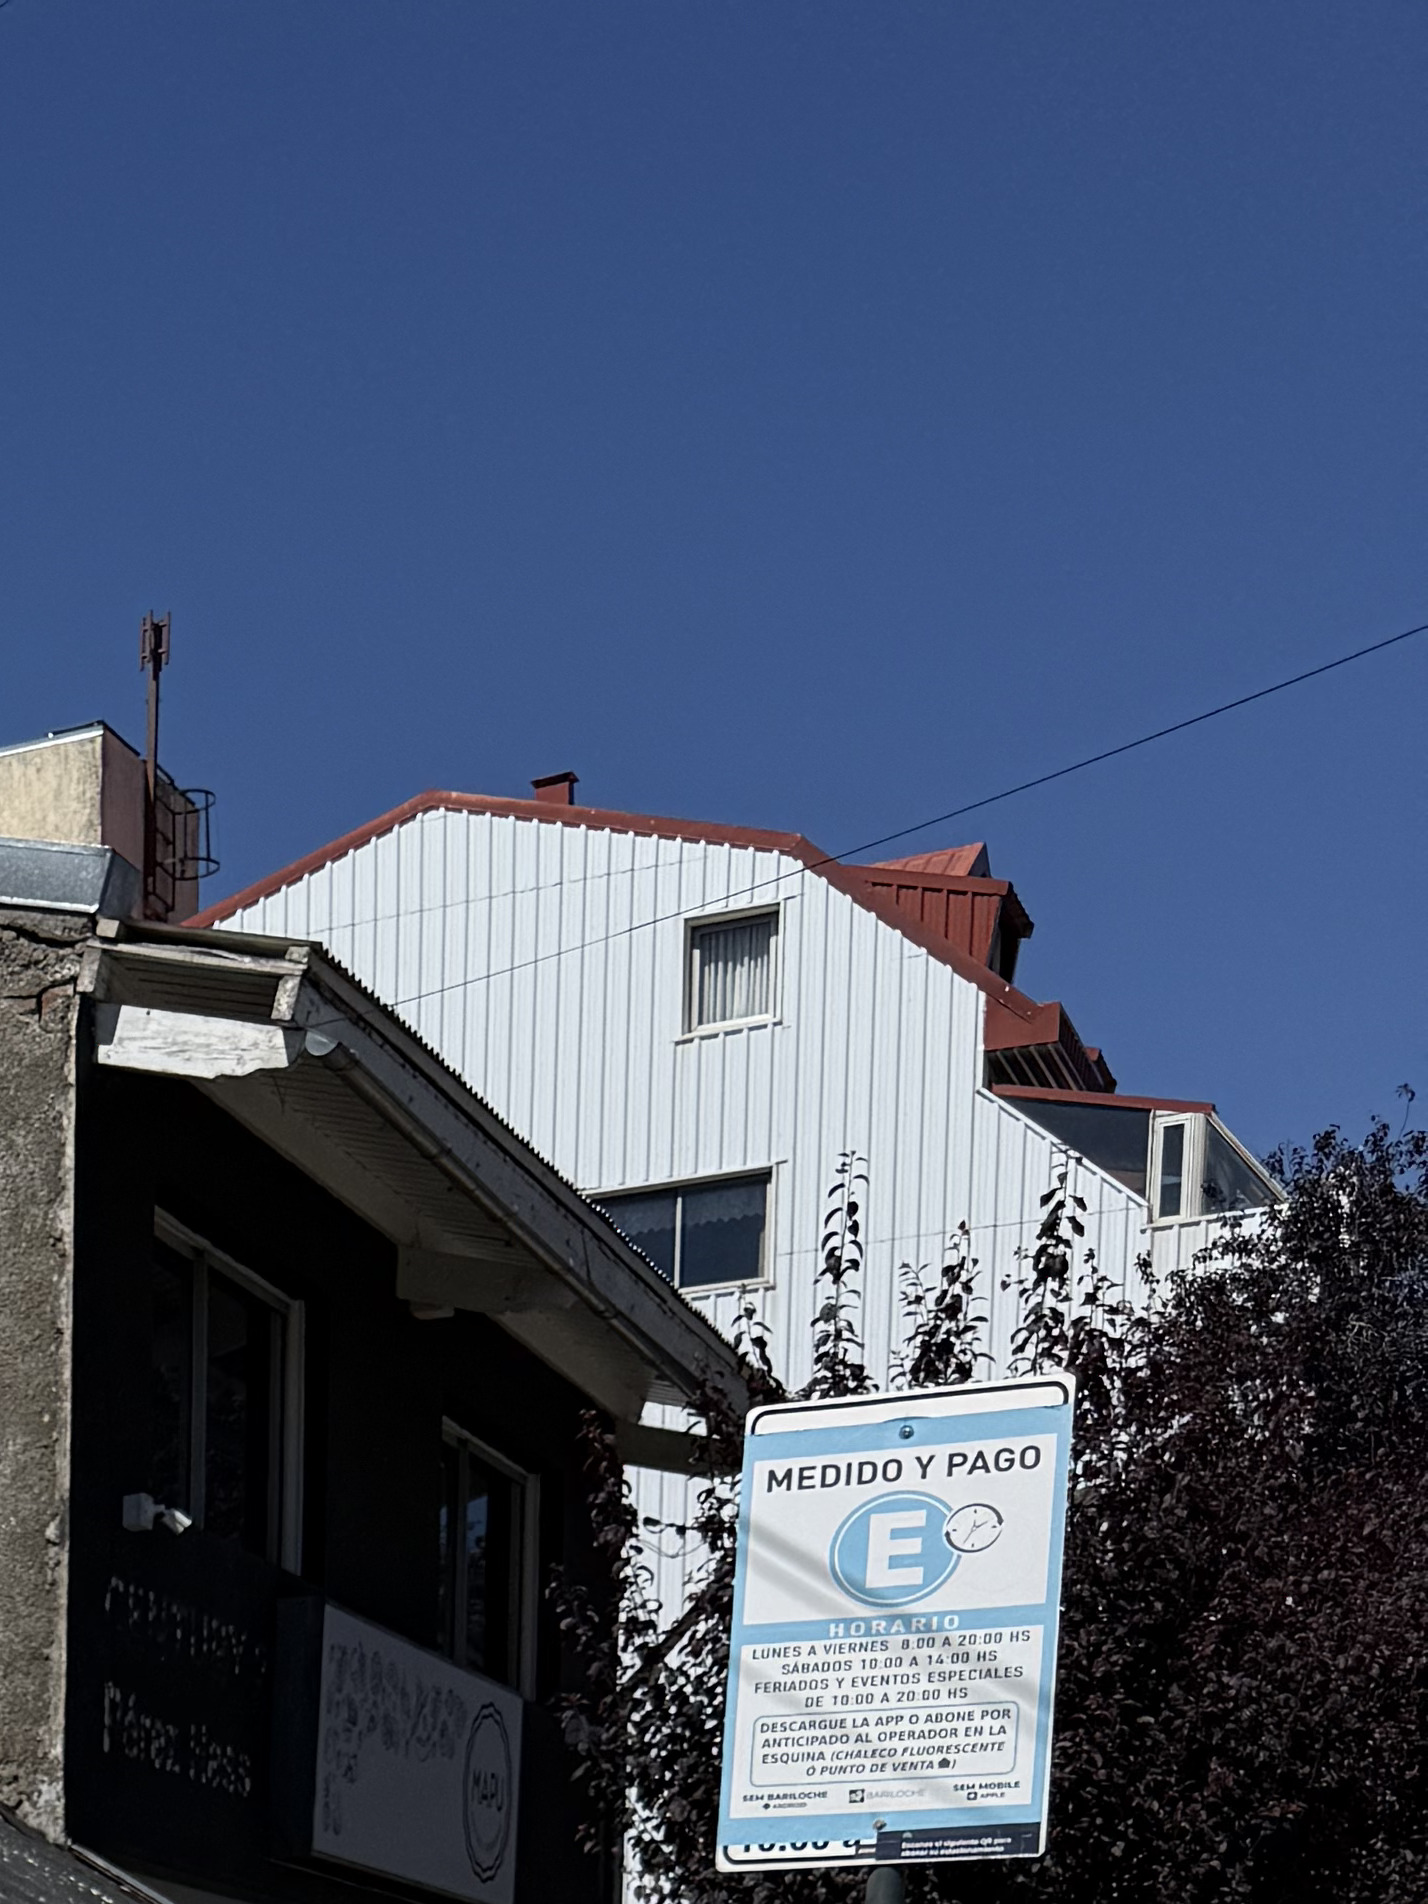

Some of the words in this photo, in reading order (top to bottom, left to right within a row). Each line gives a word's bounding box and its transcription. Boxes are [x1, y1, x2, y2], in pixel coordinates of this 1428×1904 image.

[766, 1458, 903, 1493] MEDIDO
[914, 1454, 936, 1480] Y
[946, 1444, 1042, 1478] PAGO
[864, 1509, 927, 1589] E
[829, 1614, 960, 1638] HORARIO
[752, 1645, 802, 1660] LUNES
[807, 1644, 817, 1657] A
[823, 1639, 890, 1656] VIERNES
[941, 1635, 952, 1648] A
[957, 1631, 1003, 1648] 20:00
[1009, 1629, 1031, 1643] HS
[781, 1659, 853, 1676] SÁBADOS
[860, 1656, 903, 1670] 10:00
[908, 1655, 919, 1668] A
[927, 1651, 970, 1666] 14:00
[976, 1649, 998, 1663] HS
[754, 1678, 829, 1694] FERIADOS
[835, 1677, 845, 1689] Y
[851, 1672, 921, 1688] EVENTOS
[927, 1665, 1024, 1684] ESPECIALES
[804, 1695, 824, 1708] DE
[832, 1692, 874, 1706] 10:00
[880, 1691, 890, 1704] A
[896, 1688, 941, 1703] 20:00
[947, 1686, 968, 1699] HS
[760, 1717, 847, 1734] DESCARGUE
[852, 1716, 870, 1729] LA
[874, 1714, 904, 1727] APP
[908, 1713, 919, 1725] O
[924, 1710, 975, 1724] ABONE
[980, 1708, 1012, 1721] POR
[761, 1733, 850, 1749] ANTICIPADO
[854, 1732, 873, 1745] AL
[877, 1727, 959, 1743] OPERADOR
[963, 1725, 984, 1738] EN
[988, 1724, 1007, 1736] LA
[761, 1750, 827, 1765] ESQUINA
[831, 1747, 898, 1762] (CHALECO
[900, 1741, 1006, 1757] FLUORESCENTE
[820, 1763, 866, 1776] PUNTO
[869, 1762, 888, 1774] DE
[892, 1760, 935, 1772] VENTA
[767, 1790, 828, 1801] BARILOCHE
[978, 1780, 1021, 1790] MOBILE
